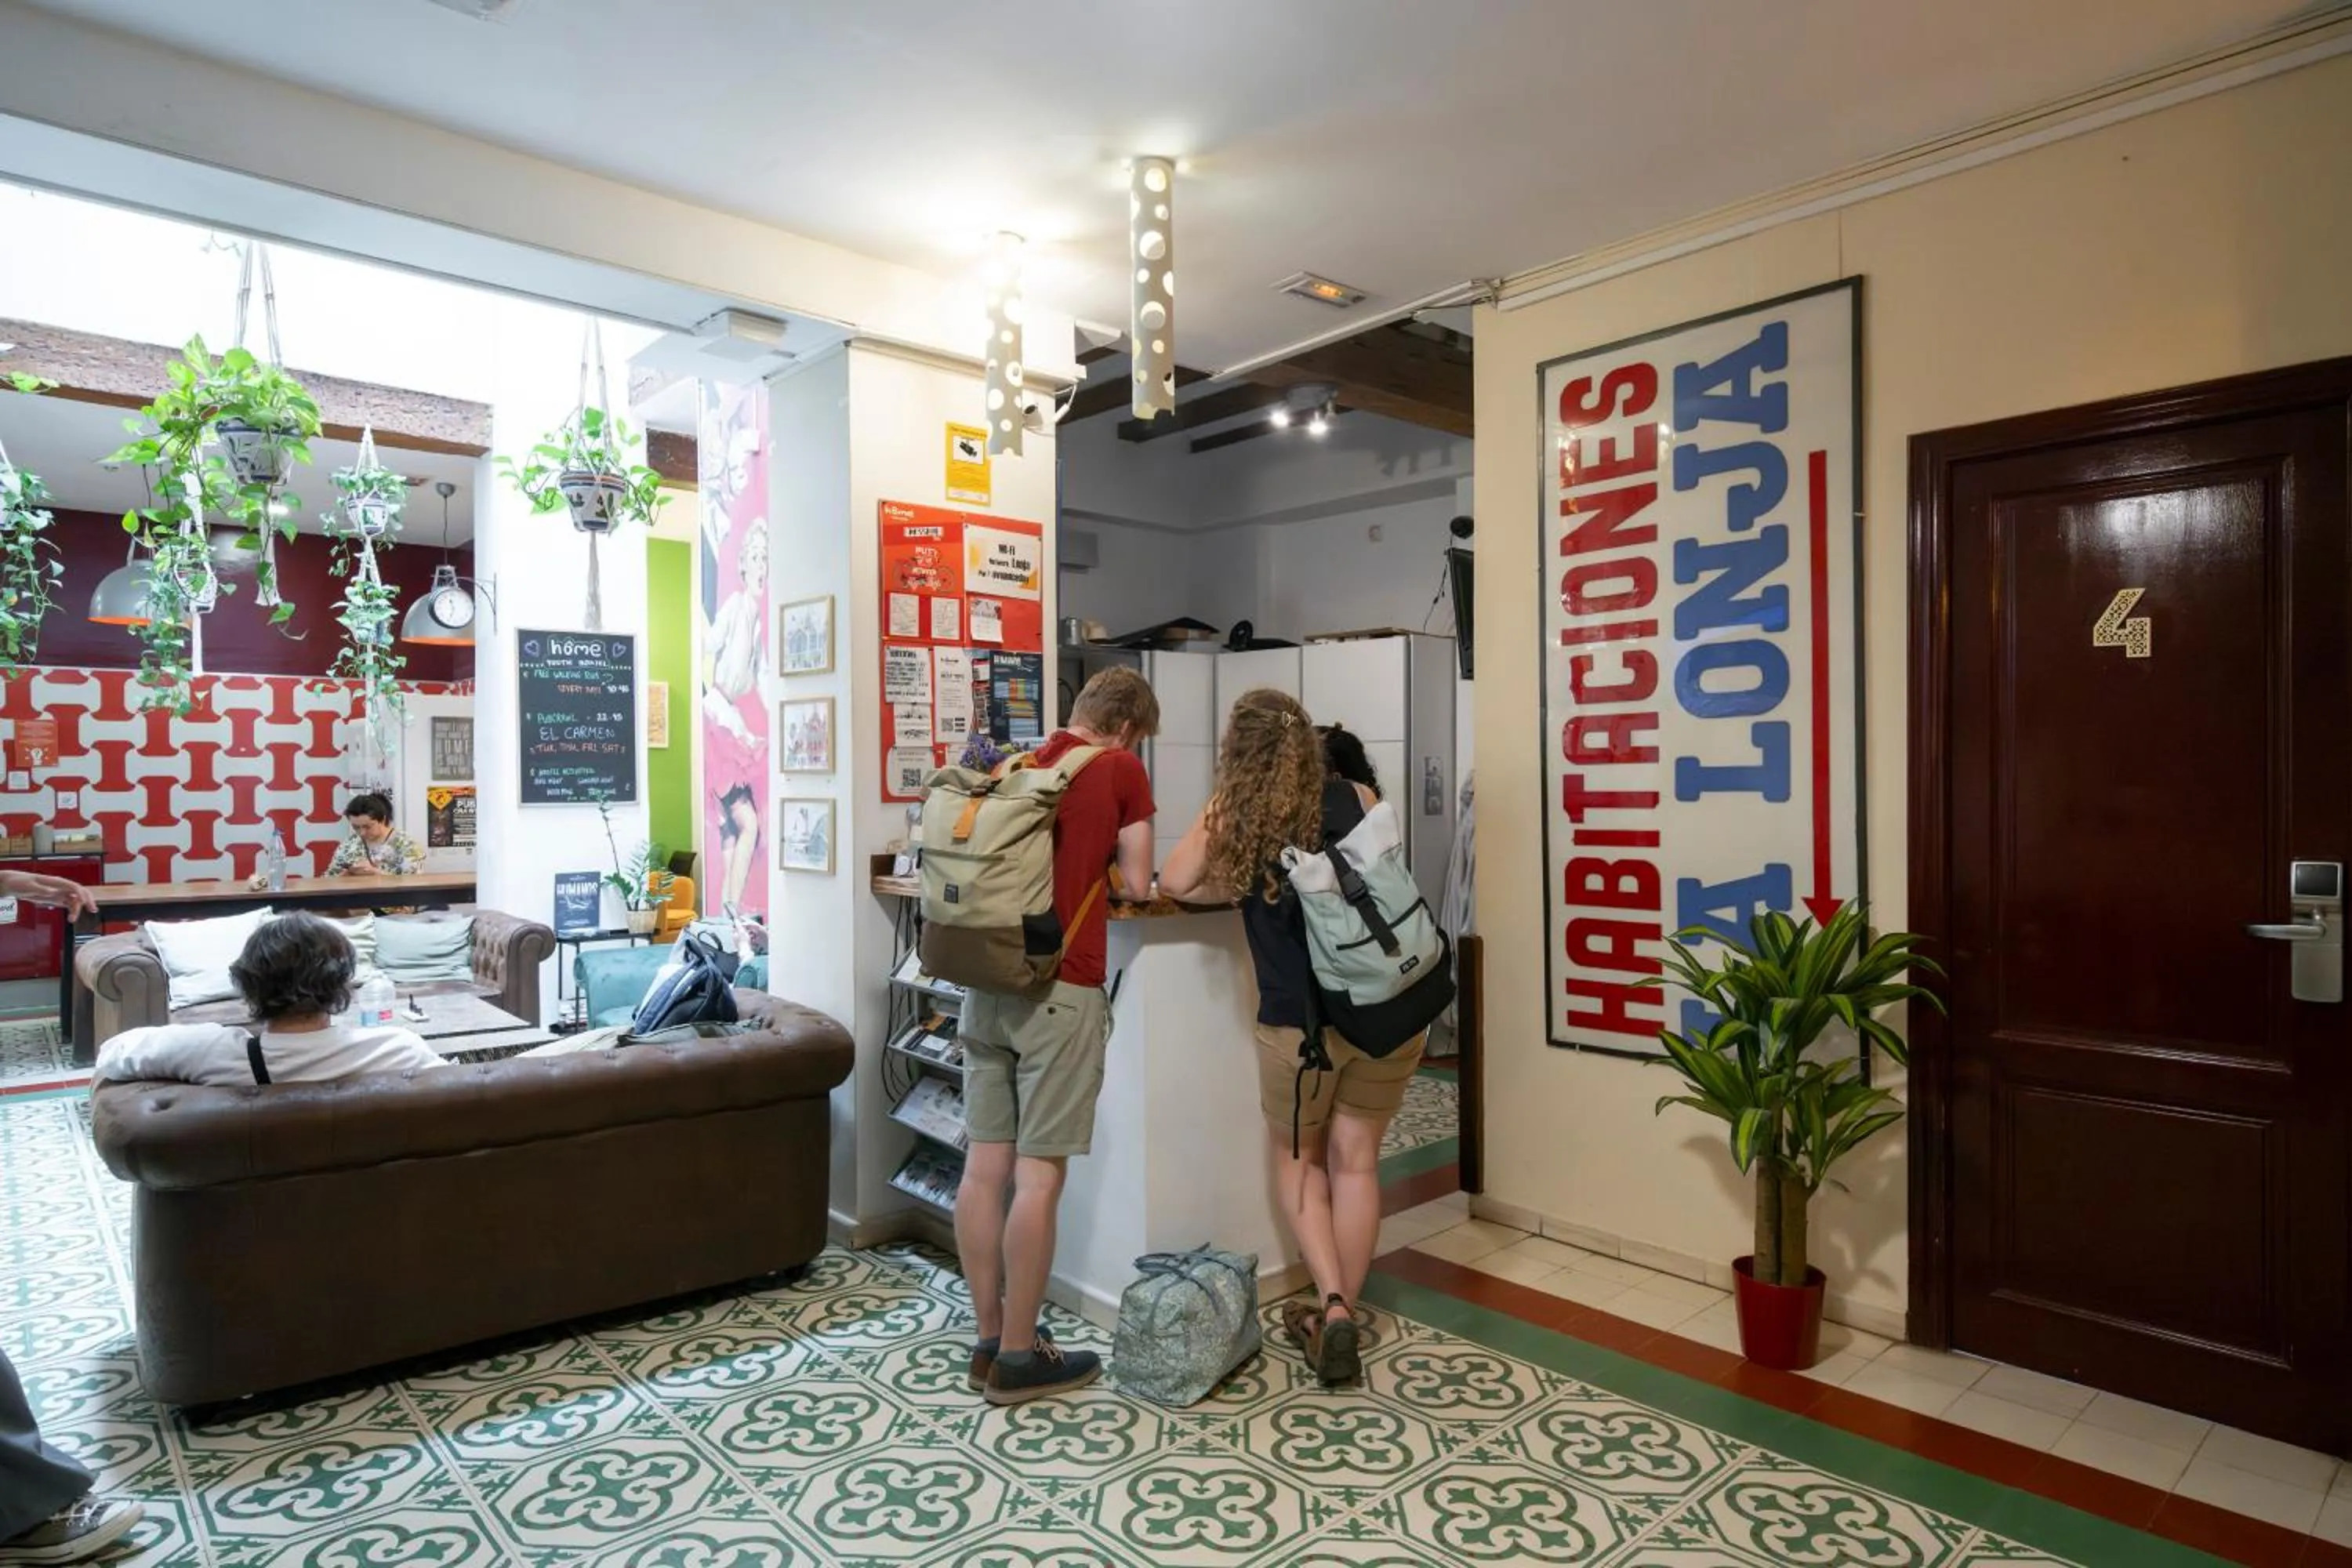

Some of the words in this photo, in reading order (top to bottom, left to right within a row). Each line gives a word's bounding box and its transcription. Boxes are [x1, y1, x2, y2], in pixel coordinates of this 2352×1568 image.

[1672, 320, 1791, 804] LONJA
[2092, 587, 2151, 658] 4
[539, 726, 560, 740] EL
[564, 725, 615, 739] CARMEN
[1558, 360, 1665, 1038] HABITACIONES
[1676, 862, 1793, 1047] A
